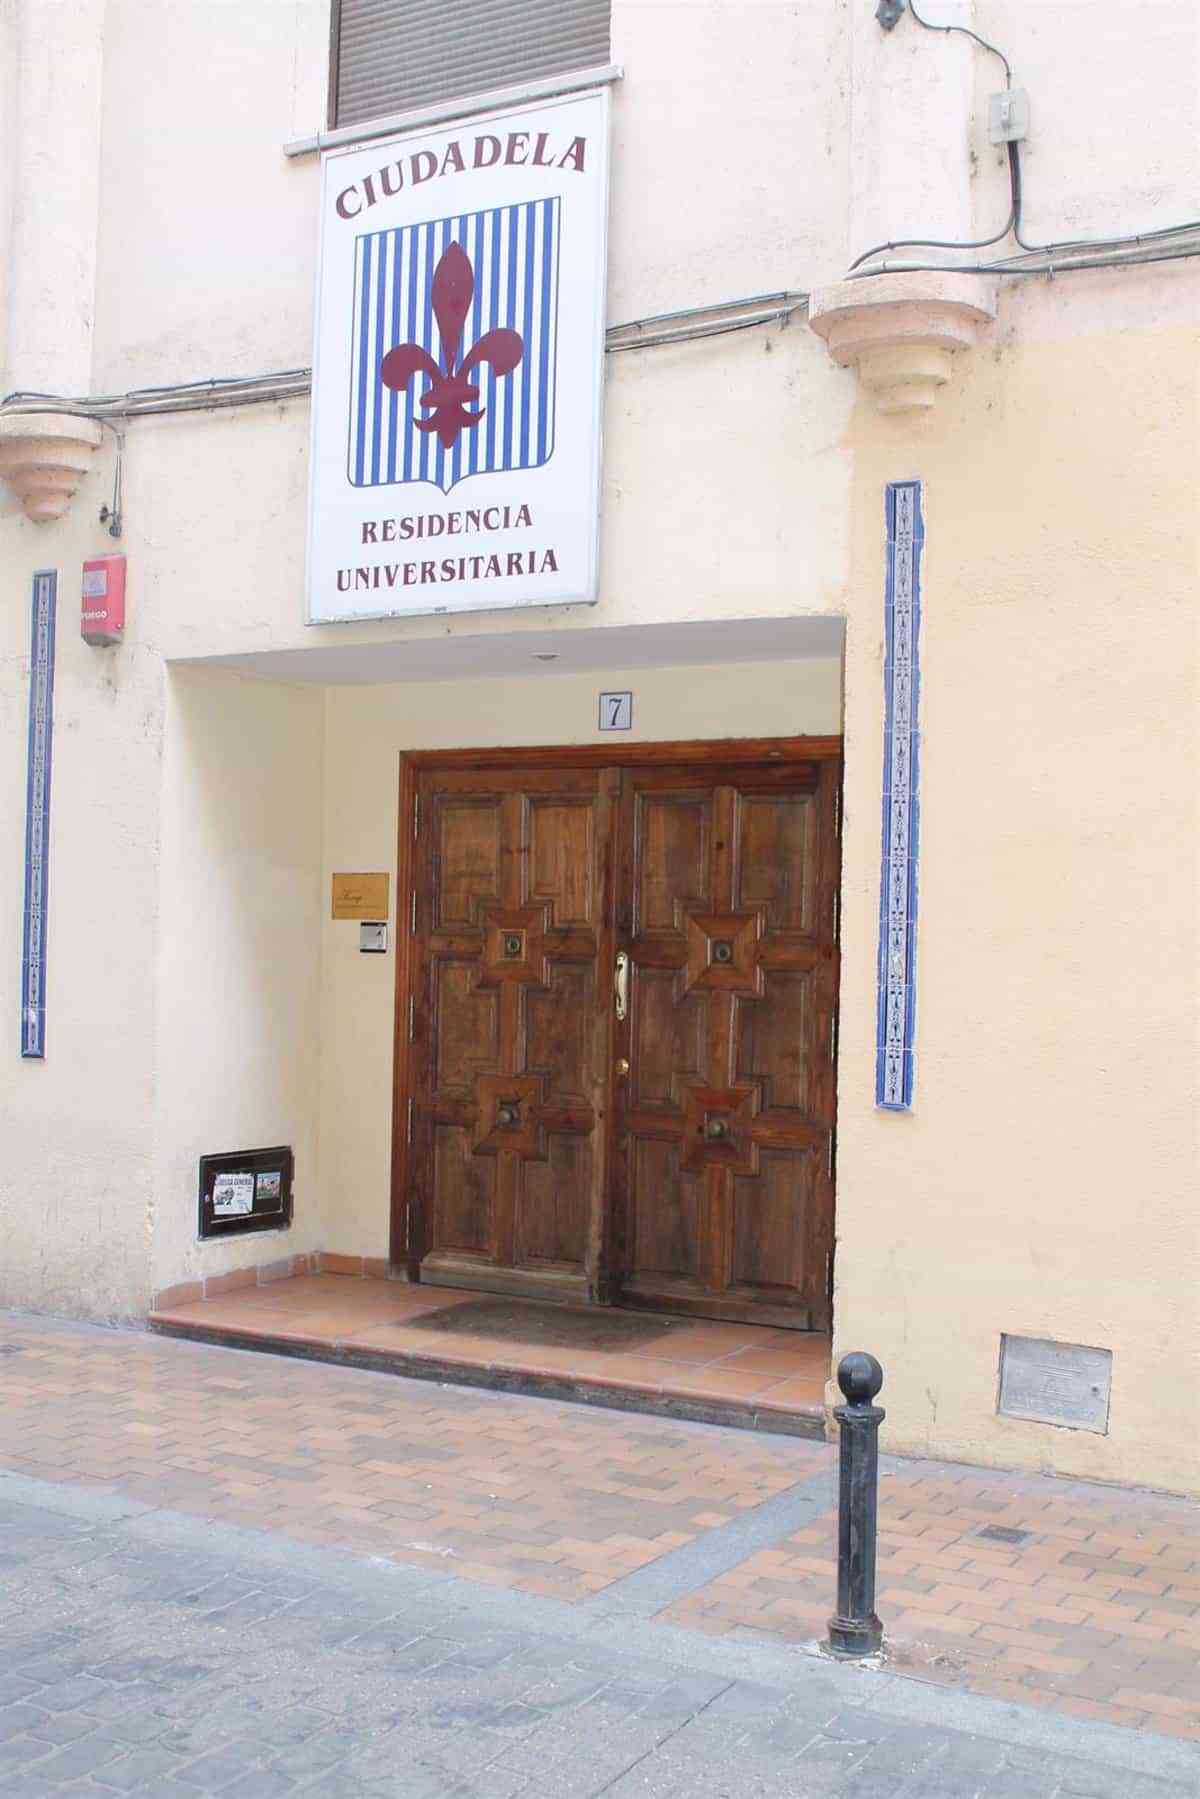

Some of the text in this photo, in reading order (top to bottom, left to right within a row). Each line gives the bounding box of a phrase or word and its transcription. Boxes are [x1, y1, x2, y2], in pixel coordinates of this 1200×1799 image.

[336, 132, 588, 219] CIUDADELA
[362, 503, 533, 545] RESIDENCIA
[337, 548, 560, 592] UNIVERSITARIA
[609, 697, 623, 726] 7
